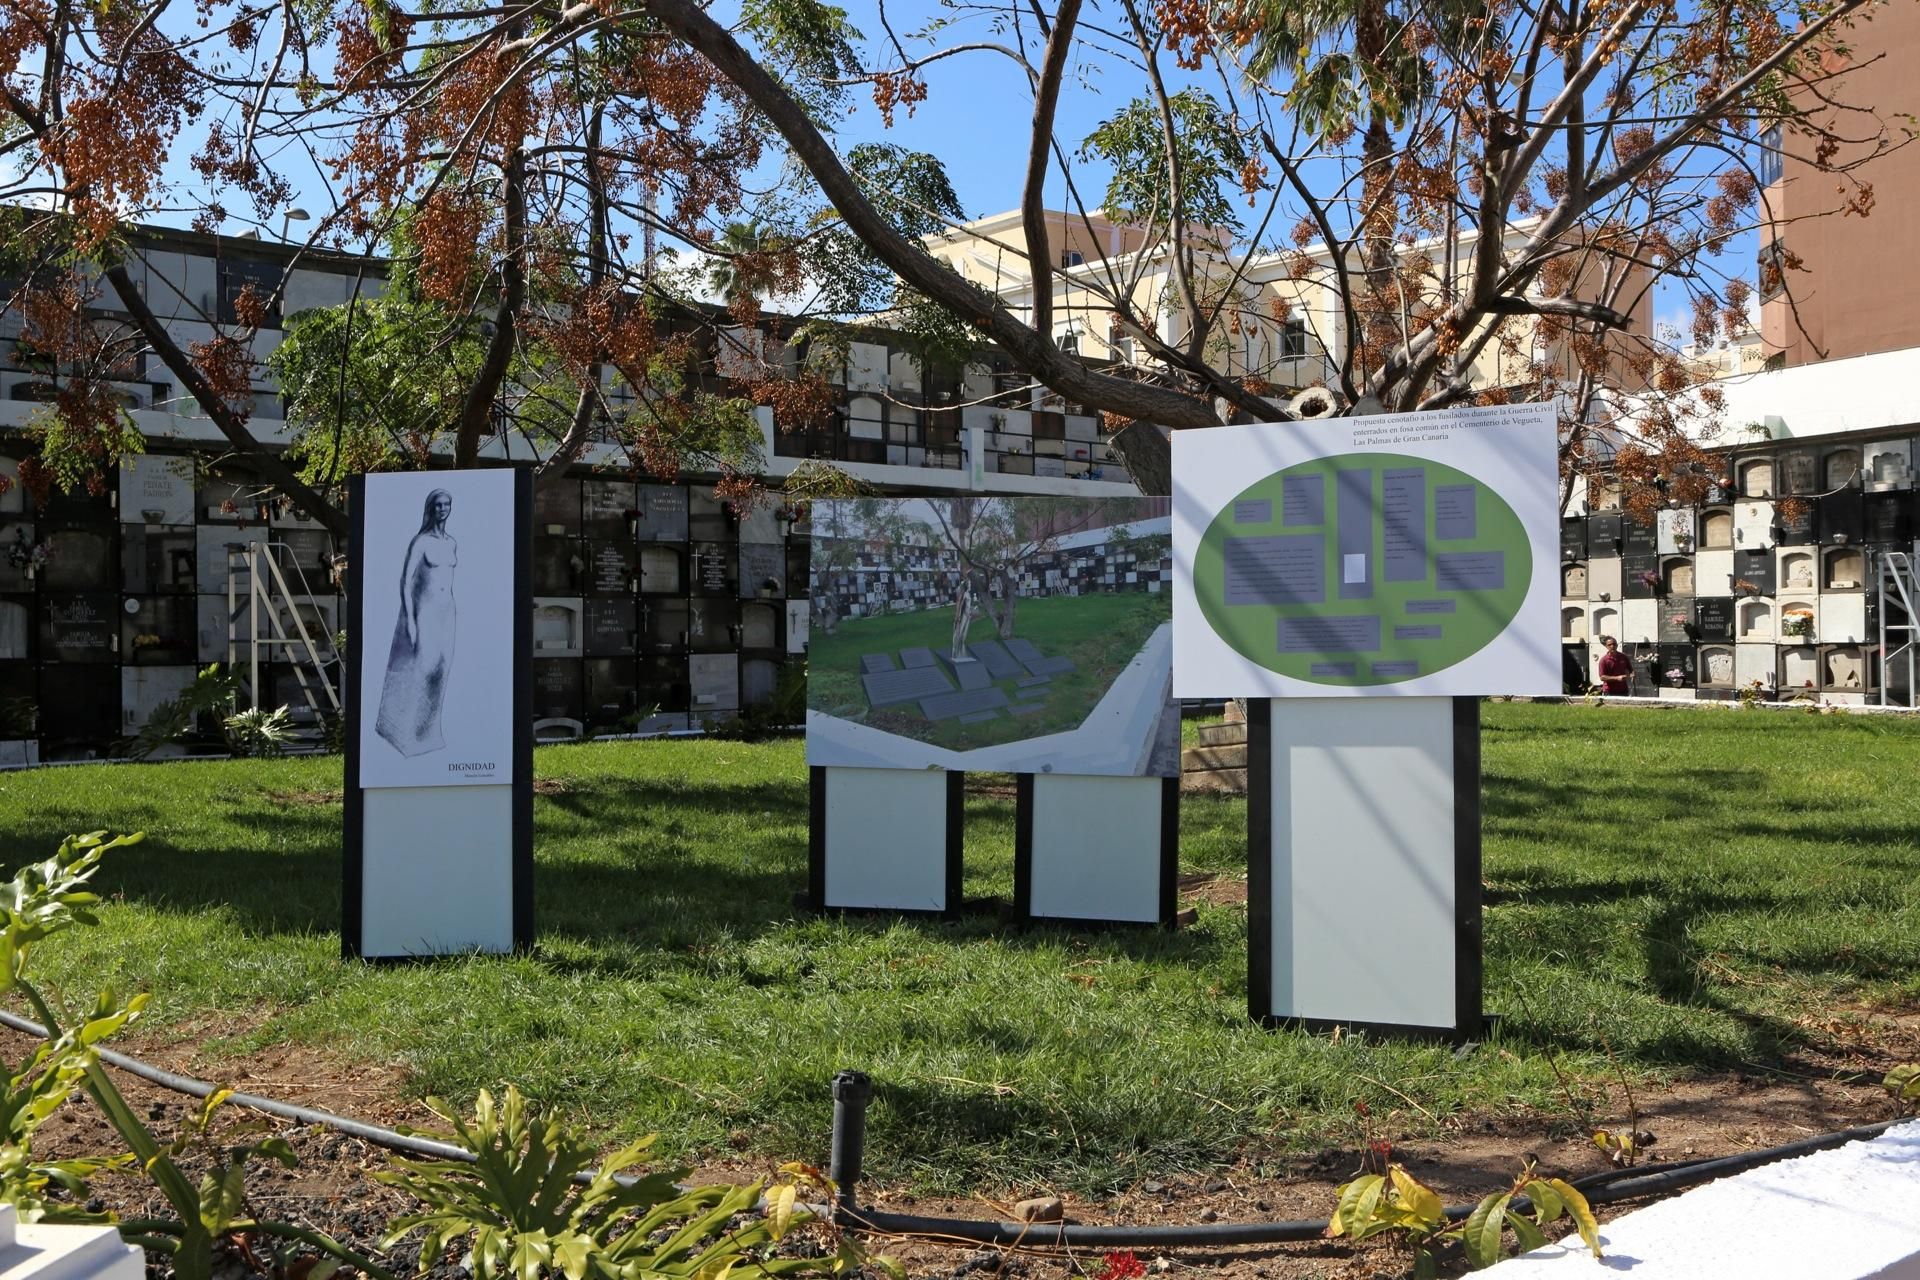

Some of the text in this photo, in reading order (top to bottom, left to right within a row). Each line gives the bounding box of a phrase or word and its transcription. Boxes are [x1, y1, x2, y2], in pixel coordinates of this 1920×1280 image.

[1353, 417, 1386, 427] Propuesta
[1387, 414, 1419, 424] cenotafio
[1426, 413, 1437, 421] los
[1438, 410, 1470, 420] fusilados
[1471, 409, 1498, 418] durante
[1507, 407, 1533, 415] Guerra
[1534, 404, 1553, 413] Civil
[1353, 427, 1388, 436] enterrados
[1399, 425, 1414, 433] fosa
[1415, 423, 1439, 432] común
[1450, 421, 1457, 429] el
[1458, 418, 1500, 428] Cementerio
[1512, 416, 1543, 426] Vegueta,
[1353, 438, 1366, 446] Las
[1367, 436, 1392, 445] Palmas
[1402, 434, 1421, 443] Gran
[1421, 432, 1449, 441] Canaria
[448, 762, 495, 771] DIGNIDAD
